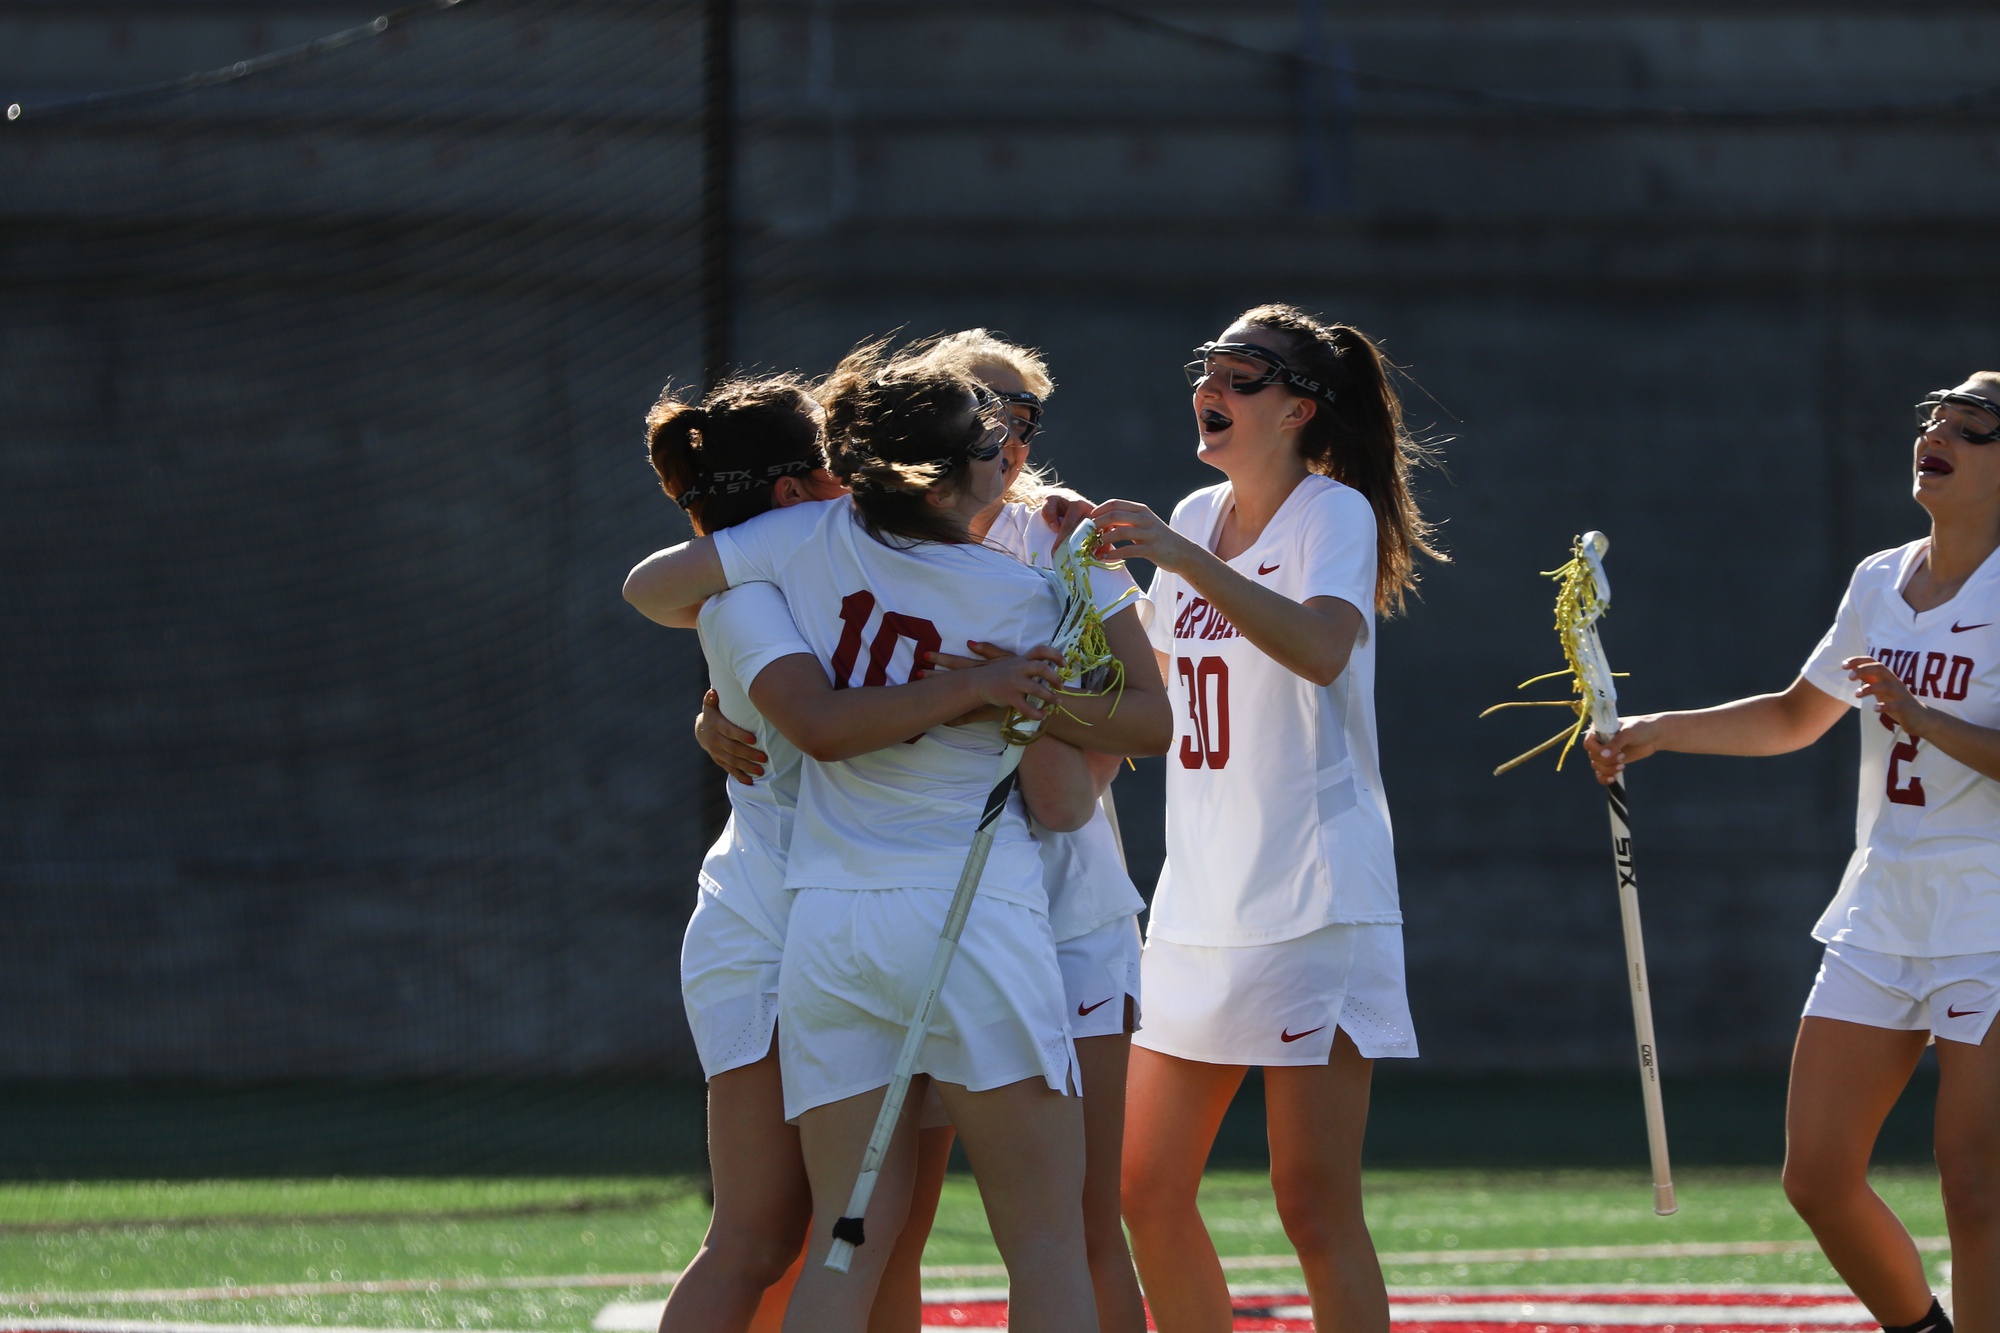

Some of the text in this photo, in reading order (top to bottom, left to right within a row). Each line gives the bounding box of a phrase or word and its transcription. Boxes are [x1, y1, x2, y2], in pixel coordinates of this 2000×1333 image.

[1289, 372, 1321, 392] STX
[713, 460, 811, 482] STX STX
[832, 589, 943, 744] 10
[1177, 656, 1230, 769] 30
[1879, 711, 1926, 806] 2
[1614, 836, 1637, 889] STX
